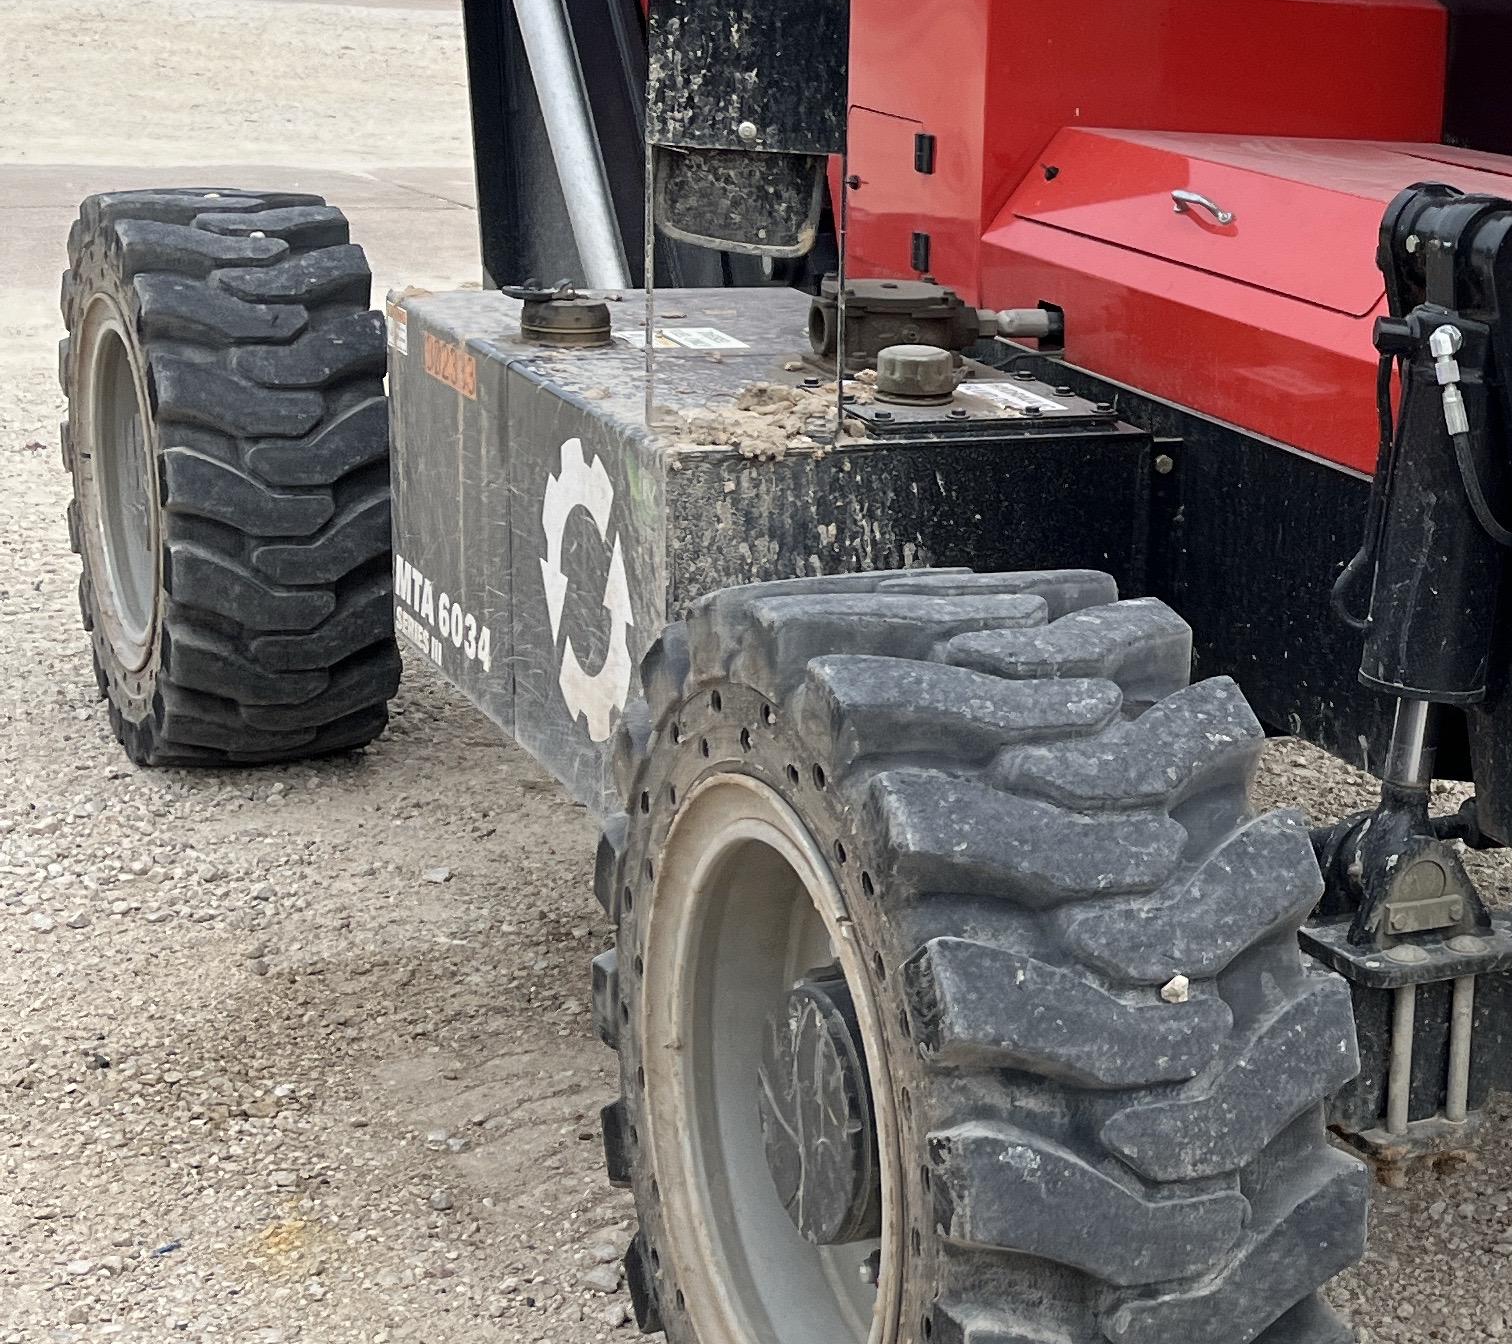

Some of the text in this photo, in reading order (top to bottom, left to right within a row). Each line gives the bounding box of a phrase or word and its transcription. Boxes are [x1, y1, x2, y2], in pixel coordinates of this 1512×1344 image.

[395, 554, 491, 673] MTA 6034
[395, 606, 430, 655] SERIES
